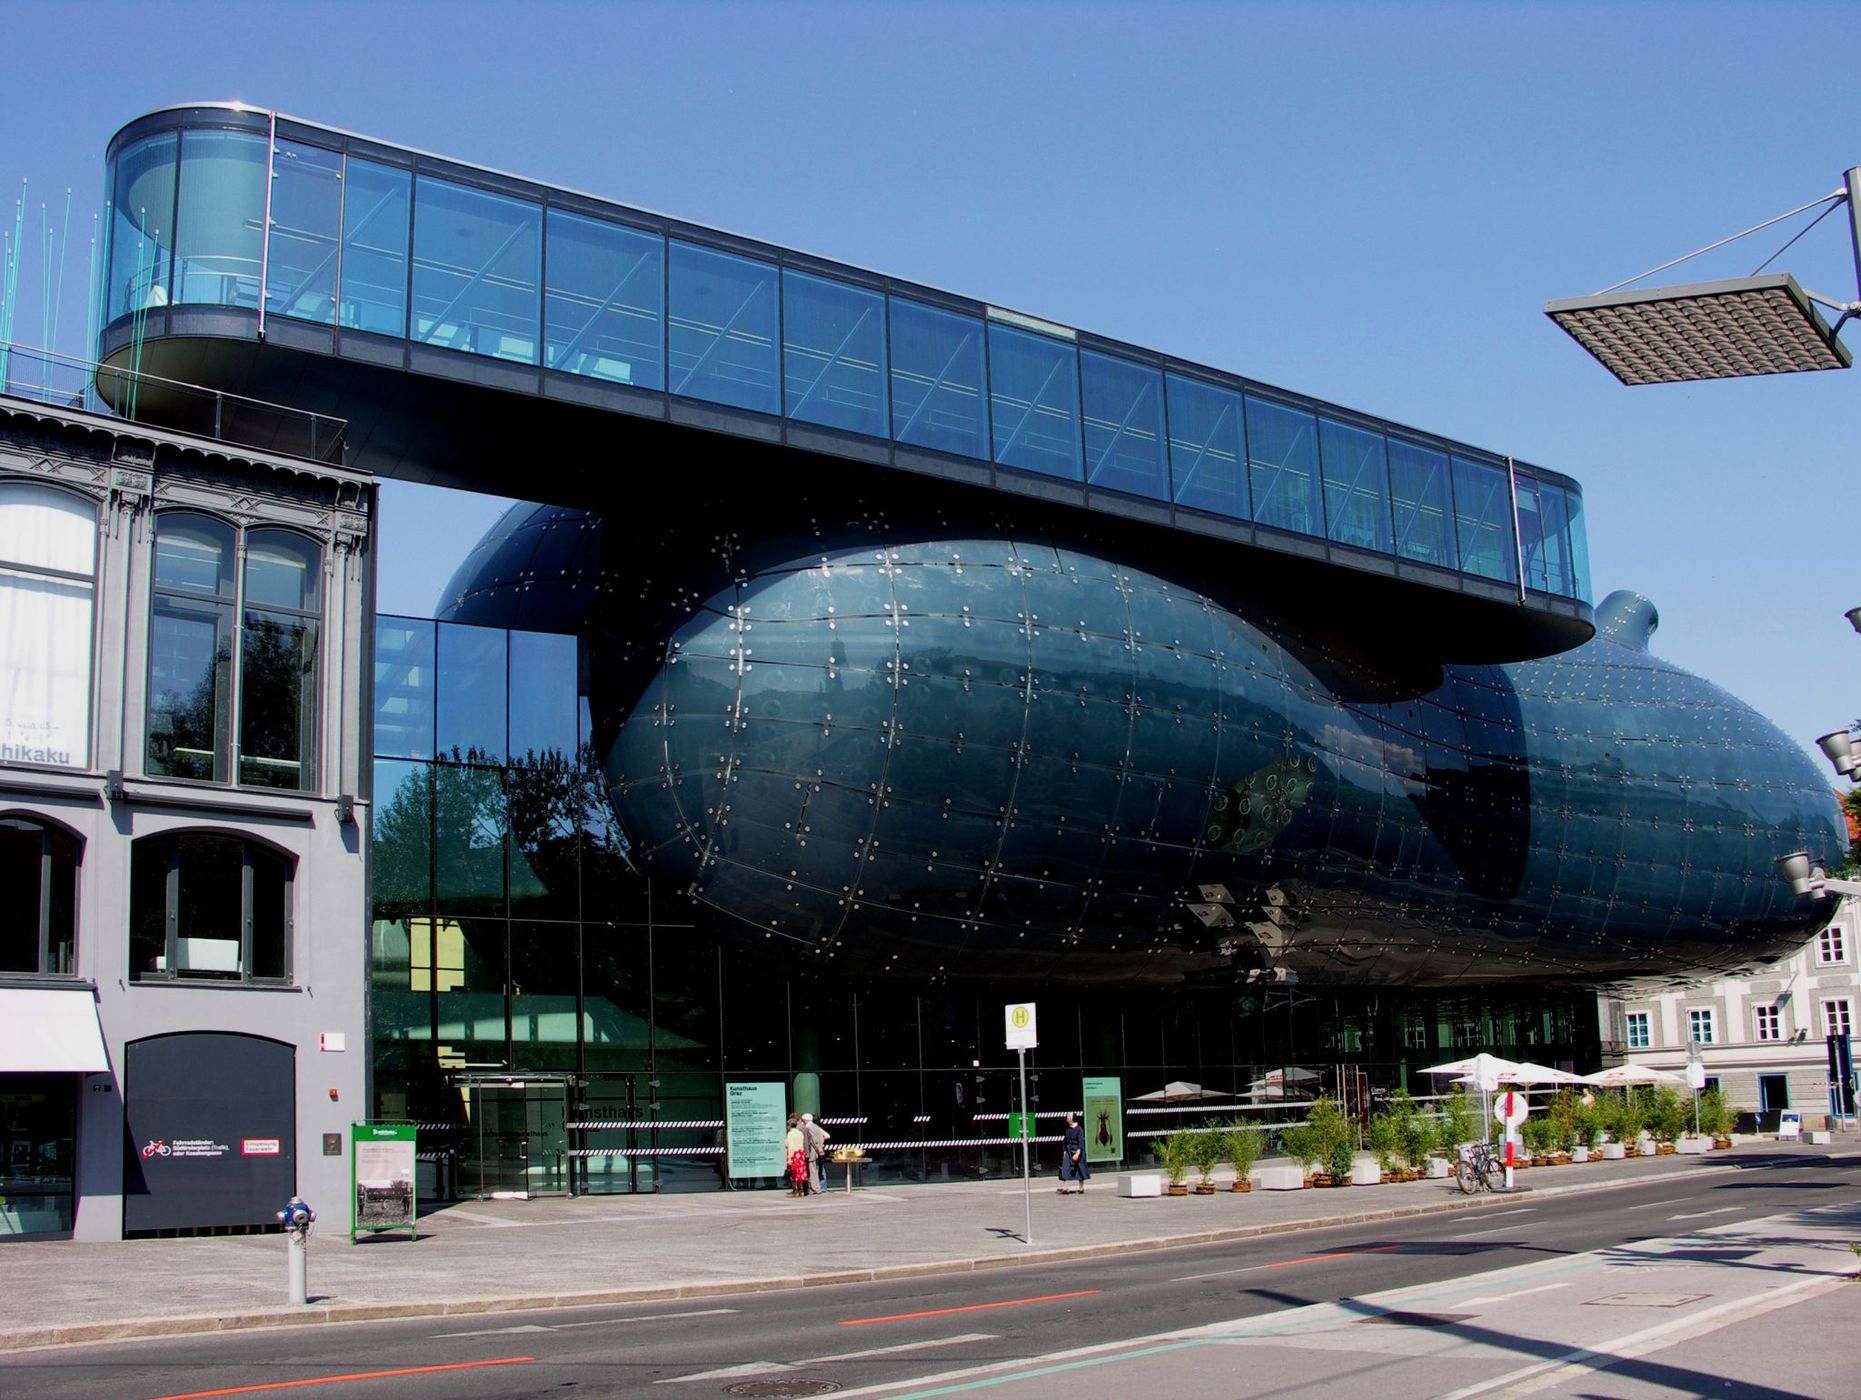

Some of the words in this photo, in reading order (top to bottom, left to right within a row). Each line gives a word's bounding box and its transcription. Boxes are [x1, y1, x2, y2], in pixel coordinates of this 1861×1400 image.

[1, 743, 70, 764] hikaku
[1015, 1010, 1025, 1024] H
[562, 1105, 644, 1119] nsthas
